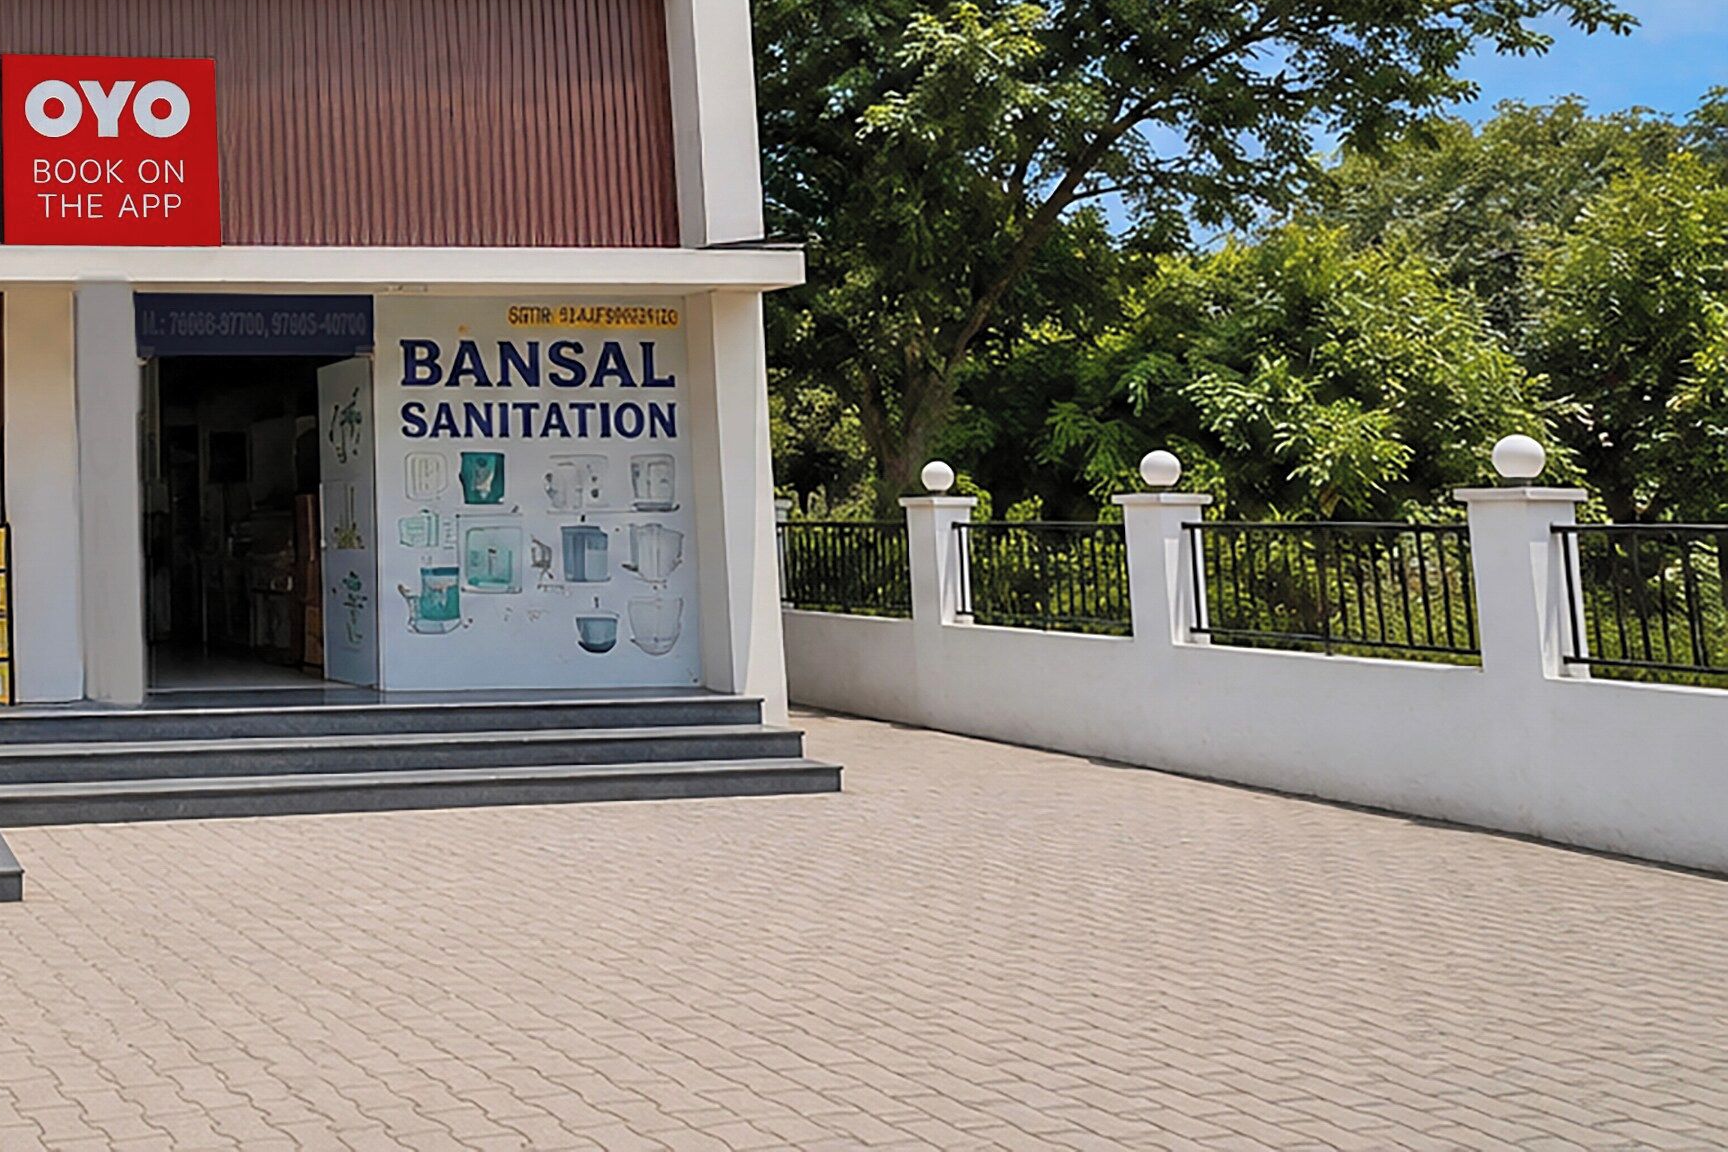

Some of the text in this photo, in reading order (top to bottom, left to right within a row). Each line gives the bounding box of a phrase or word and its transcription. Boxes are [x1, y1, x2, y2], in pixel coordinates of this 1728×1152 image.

[24, 79, 191, 138] OYO
[33, 158, 185, 184] BOOK ON
[37, 193, 182, 219] THE APP
[400, 338, 676, 388] BANSAL
[401, 401, 678, 439] SANITATION
